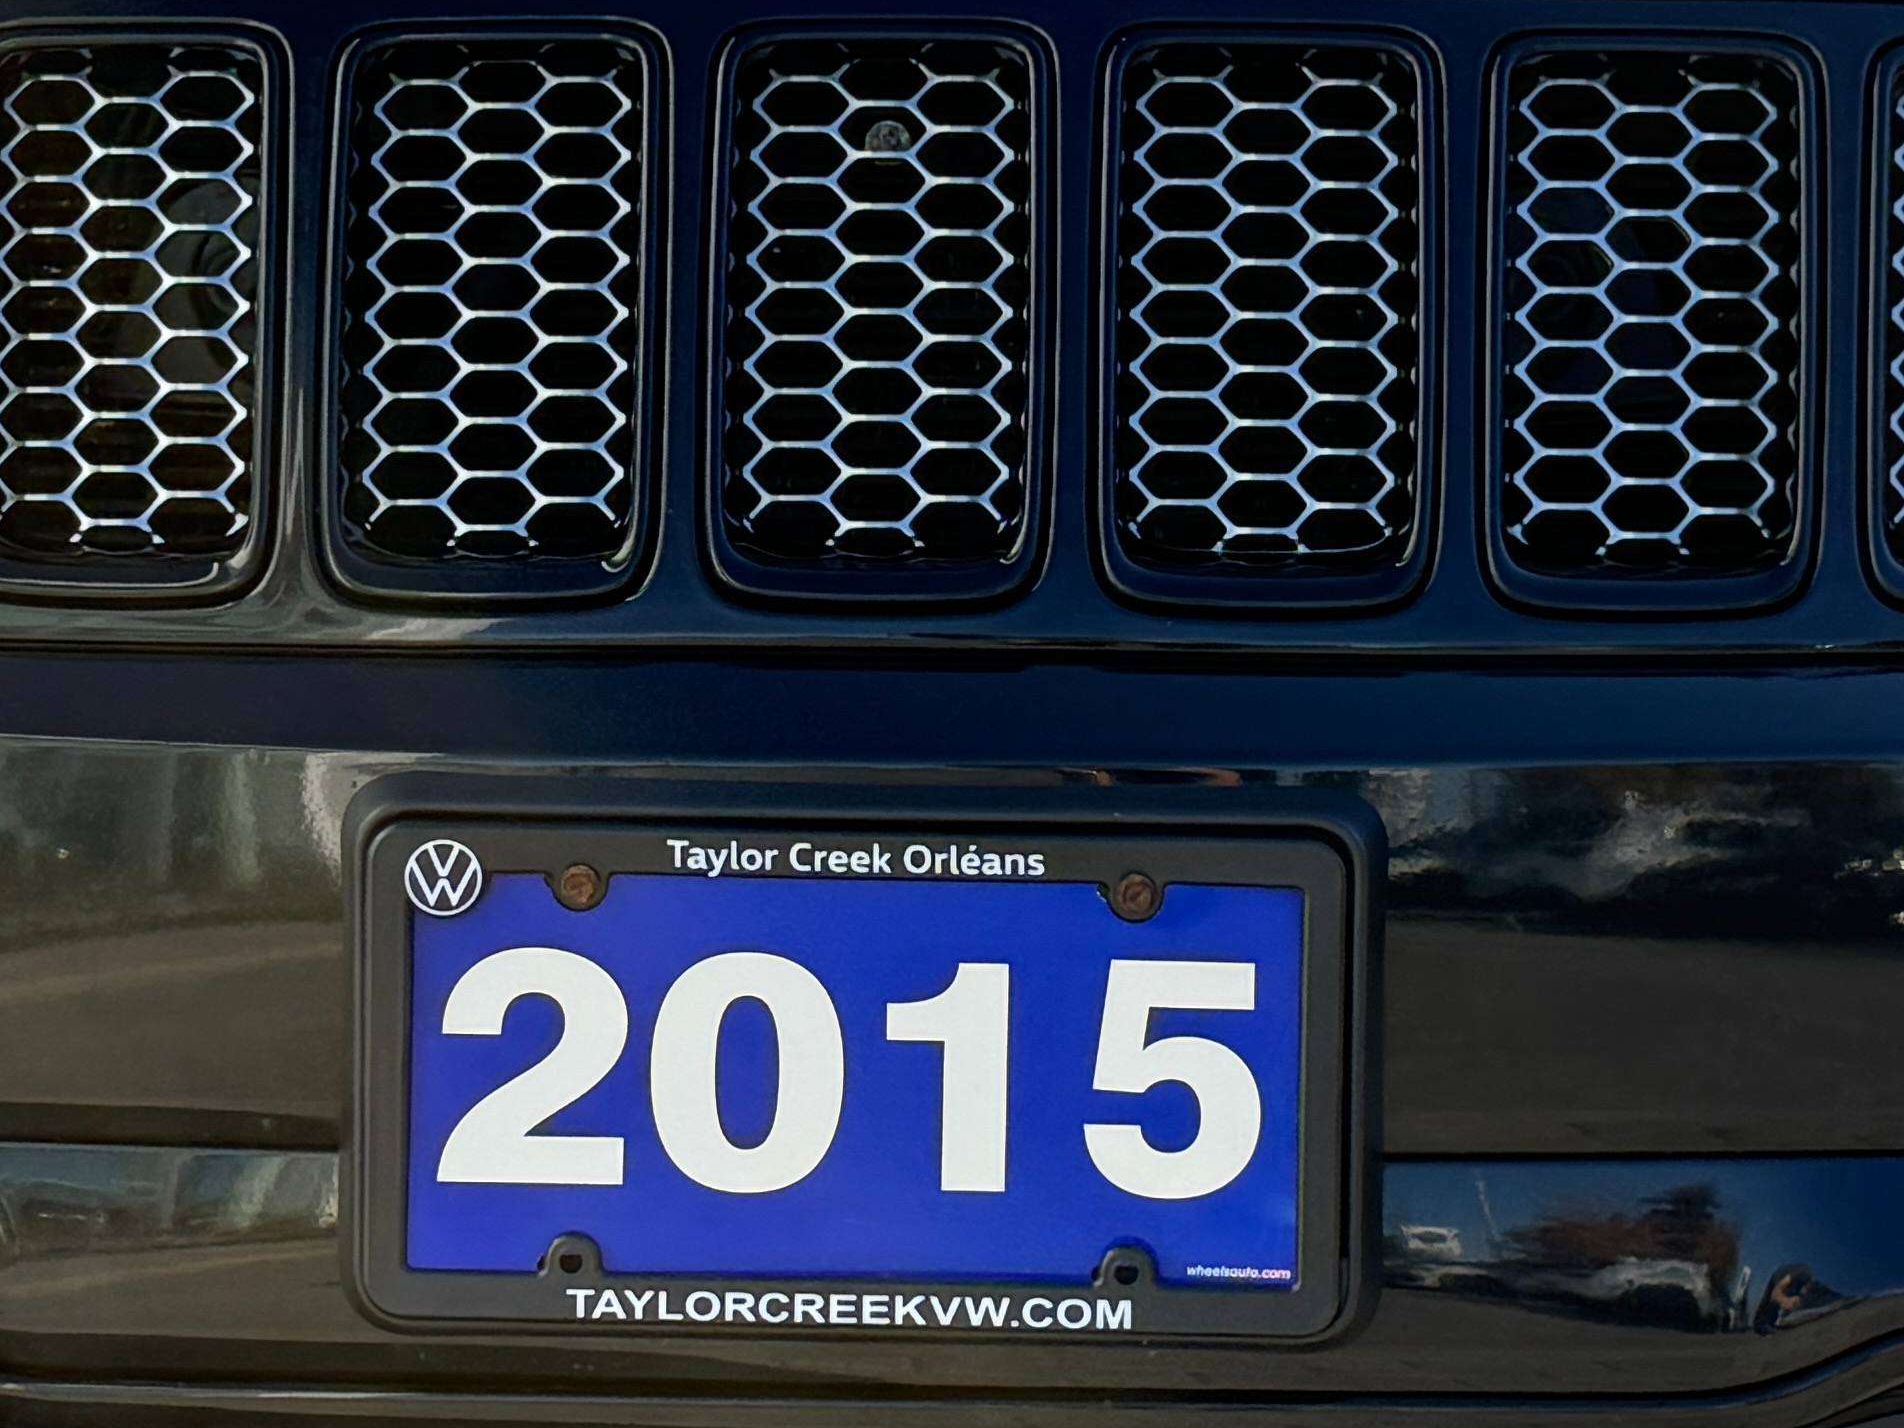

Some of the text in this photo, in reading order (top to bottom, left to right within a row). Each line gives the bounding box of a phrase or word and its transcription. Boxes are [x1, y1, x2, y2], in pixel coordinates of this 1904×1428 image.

[666, 838, 1046, 878] Taylor Creek Orléans
[436, 946, 1262, 1200] 2015
[1186, 1264, 1292, 1280] wheelsauto.com
[565, 1288, 1133, 1330] TAYLORCREEKVW.COM
